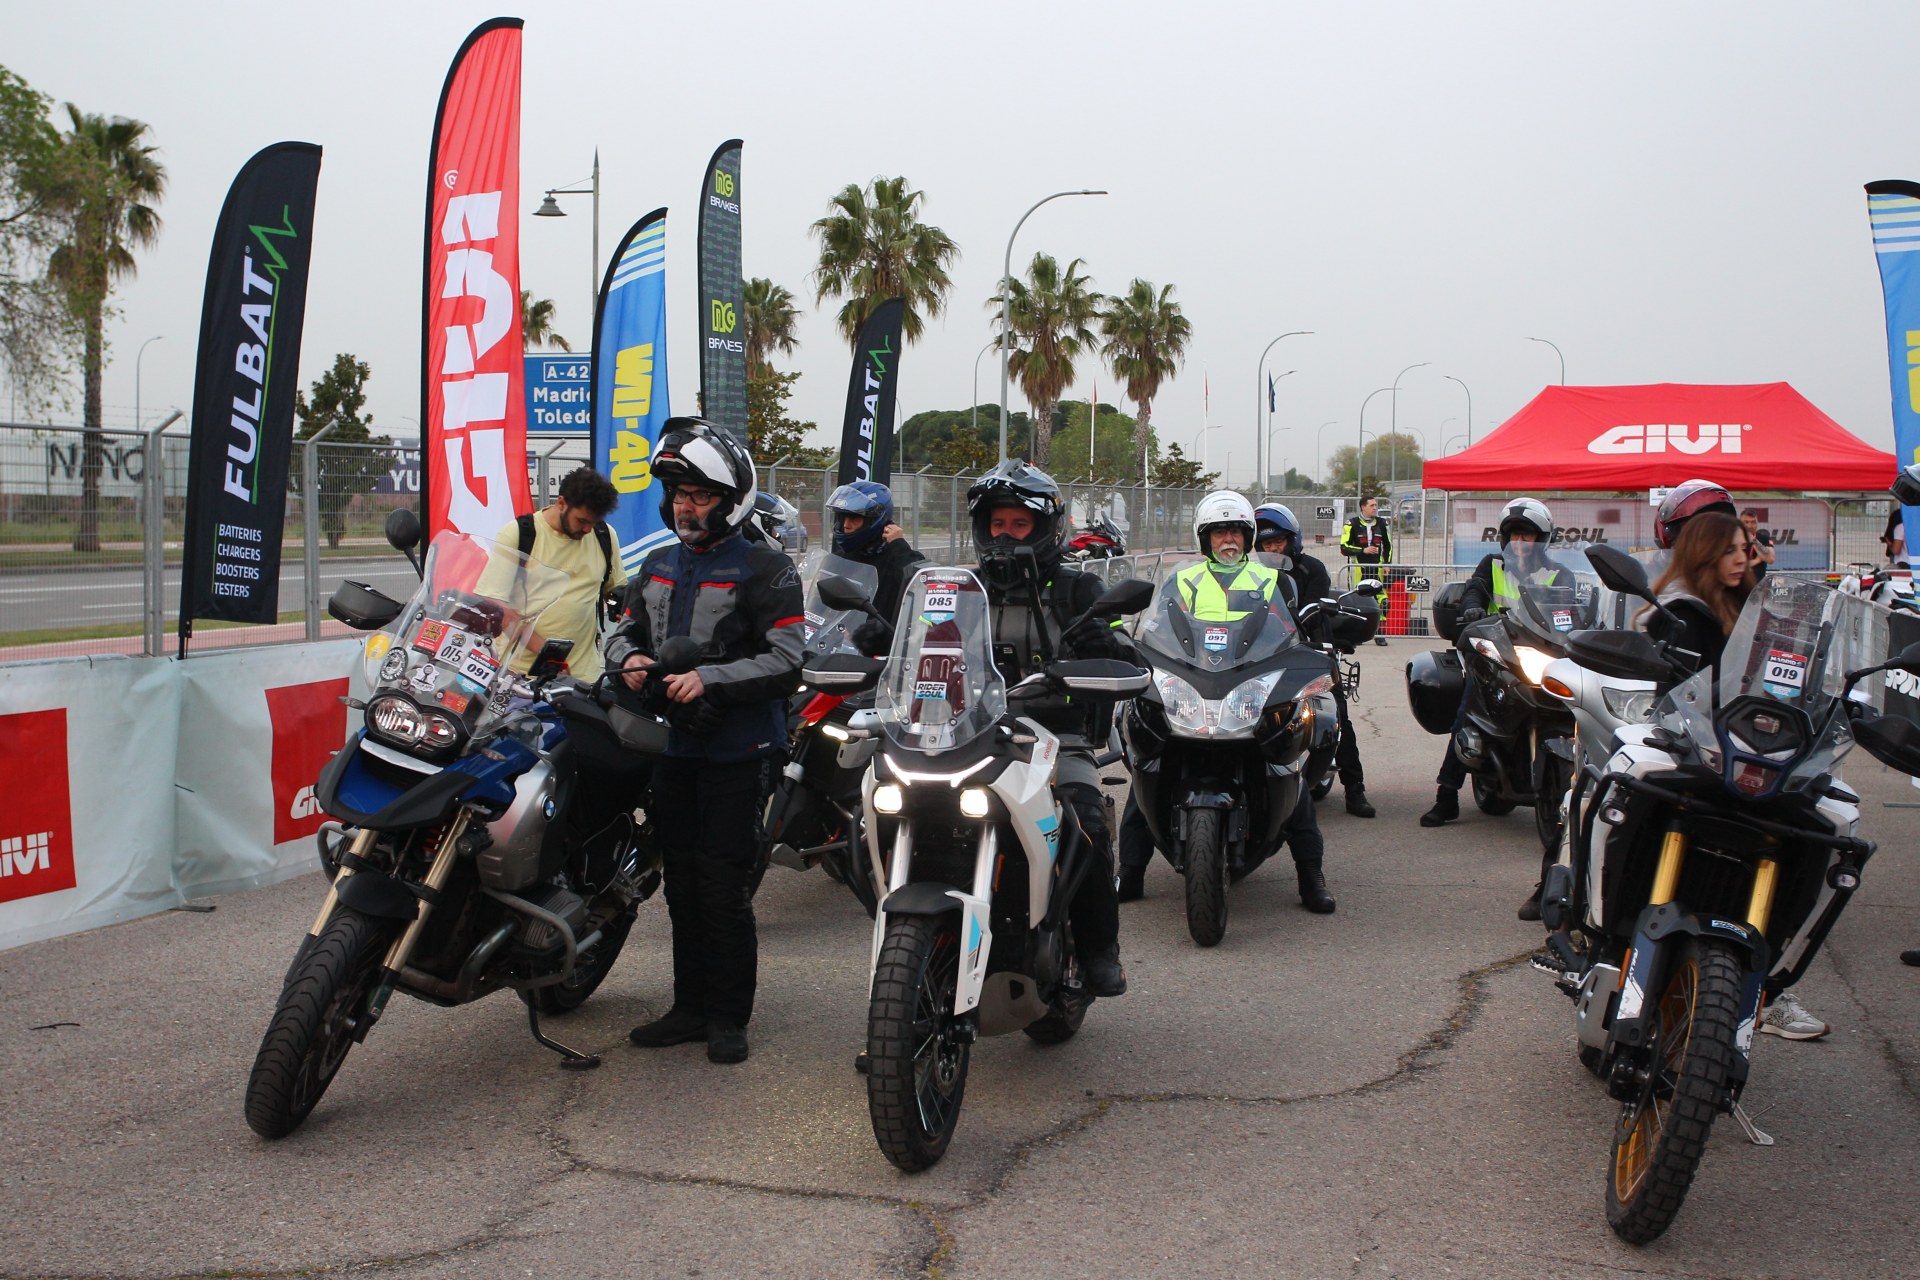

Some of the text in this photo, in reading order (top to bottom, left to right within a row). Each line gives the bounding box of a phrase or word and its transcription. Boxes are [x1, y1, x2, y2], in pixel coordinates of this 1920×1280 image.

[710, 196, 739, 215] BRAKES
[224, 254, 274, 503] FULBAT
[546, 365, 589, 379] A-42
[609, 342, 653, 494] WD-40
[856, 368, 881, 483] ULBAT
[1587, 424, 1742, 454] GIVI
[218, 523, 262, 542] BATTERIES
[1772, 529, 1799, 545] UL
[217, 543, 261, 562] CHARGERS
[215, 563, 260, 580] BOOSTERS
[214, 582, 250, 598] TESTERS
[928, 597, 953, 606] 085
[441, 645, 462, 662] 015
[467, 663, 490, 680] 091
[1772, 666, 1798, 680] 019
[918, 690, 944, 698] SOUL
[0, 831, 51, 878] IVI
